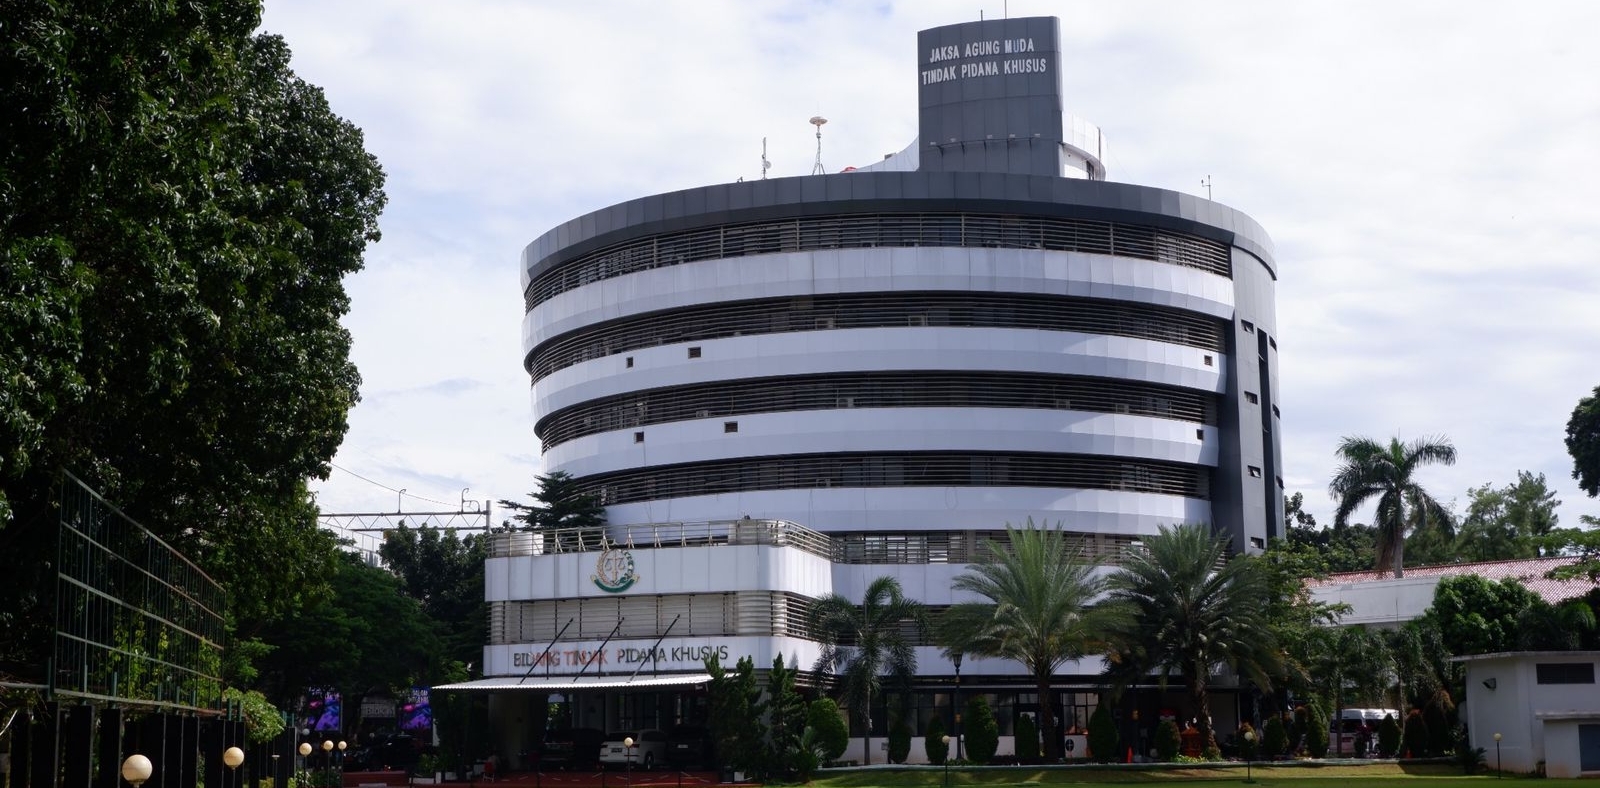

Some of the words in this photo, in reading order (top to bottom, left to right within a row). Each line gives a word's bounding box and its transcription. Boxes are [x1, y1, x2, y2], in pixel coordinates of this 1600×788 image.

[929, 45, 960, 63] JAKSA
[965, 40, 1000, 58] AGUNG
[1004, 38, 1035, 54] MUDA
[922, 65, 957, 85] TINDAK
[961, 61, 999, 79] PIDANA
[1004, 58, 1047, 75] KHUSUS
[513, 651, 561, 667] BIDANG
[617, 647, 667, 664] PIDANA
[671, 645, 729, 662] KHUSUS
